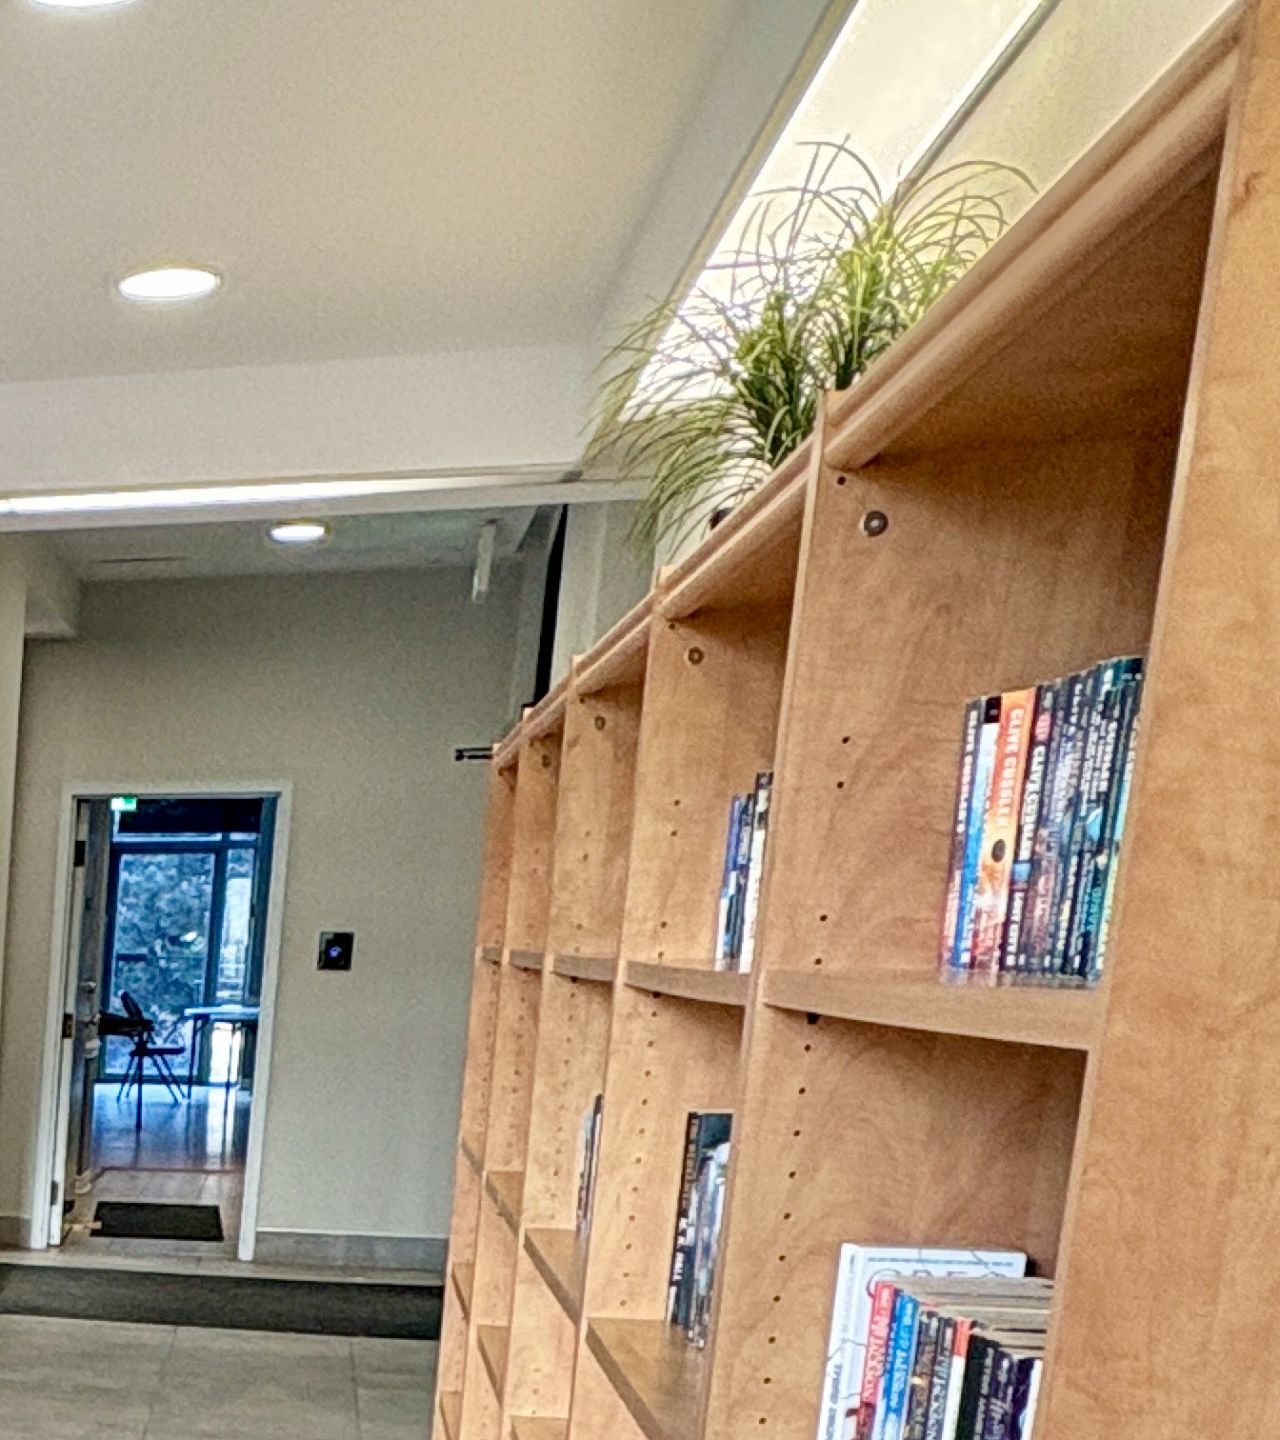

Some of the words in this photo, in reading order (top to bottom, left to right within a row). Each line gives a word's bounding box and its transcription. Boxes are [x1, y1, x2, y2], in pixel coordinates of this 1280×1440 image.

[1005, 708, 1024, 753] CLIVE
[996, 756, 1017, 827] CUSSLER
[1024, 745, 1046, 793] CLIVE
